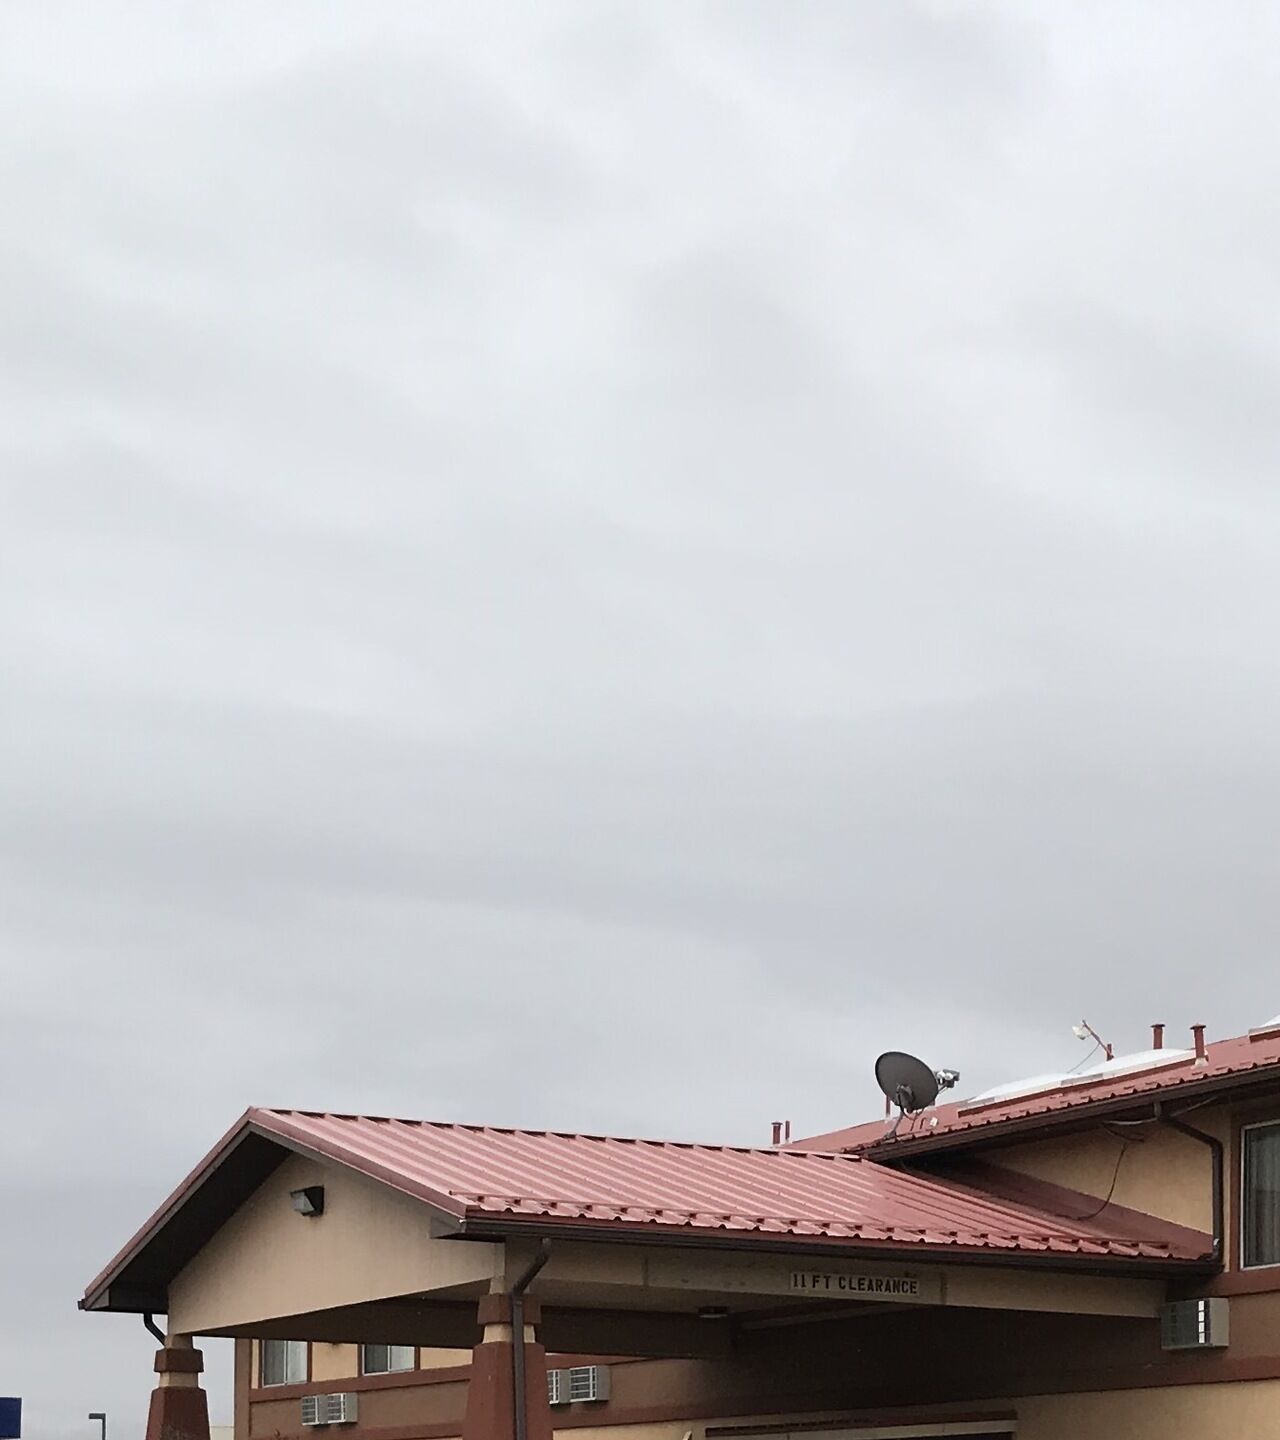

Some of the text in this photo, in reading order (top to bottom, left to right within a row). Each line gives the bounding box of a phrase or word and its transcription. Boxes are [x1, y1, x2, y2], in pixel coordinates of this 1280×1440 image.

[793, 1273, 918, 1295] 11 FT CLEARANCE
